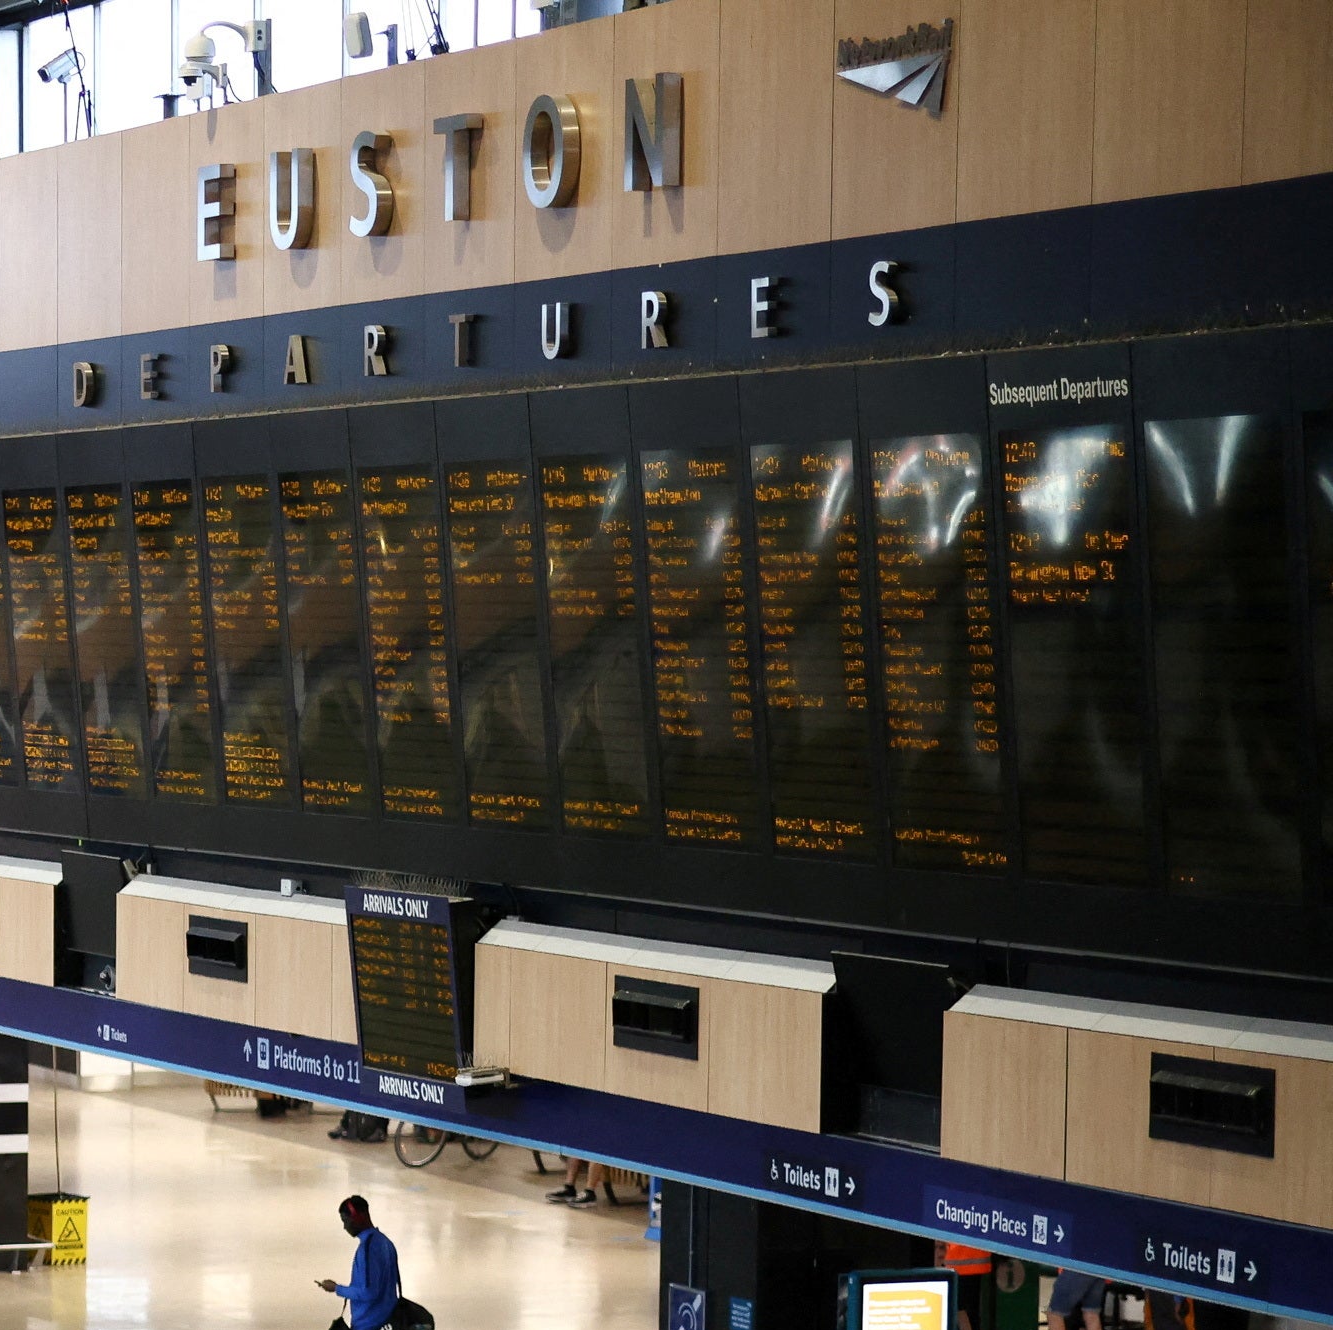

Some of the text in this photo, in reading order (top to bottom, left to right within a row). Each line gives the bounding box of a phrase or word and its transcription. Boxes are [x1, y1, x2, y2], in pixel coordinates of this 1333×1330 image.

[197, 72, 683, 262] EUSTON
[72, 260, 900, 408] DEPARTURES
[989, 376, 1129, 407] Subsequent Departures
[363, 893, 429, 919] ARRIVALS ONLY
[111, 1027, 127, 1044] Tickets
[273, 1044, 360, 1084] Platforms 8 to 11
[379, 1075, 444, 1105] ARRIVALS ONLY
[784, 1162, 821, 1191] Toilets
[936, 1199, 1027, 1237] Changing Places
[1163, 1242, 1211, 1275] Toilets
